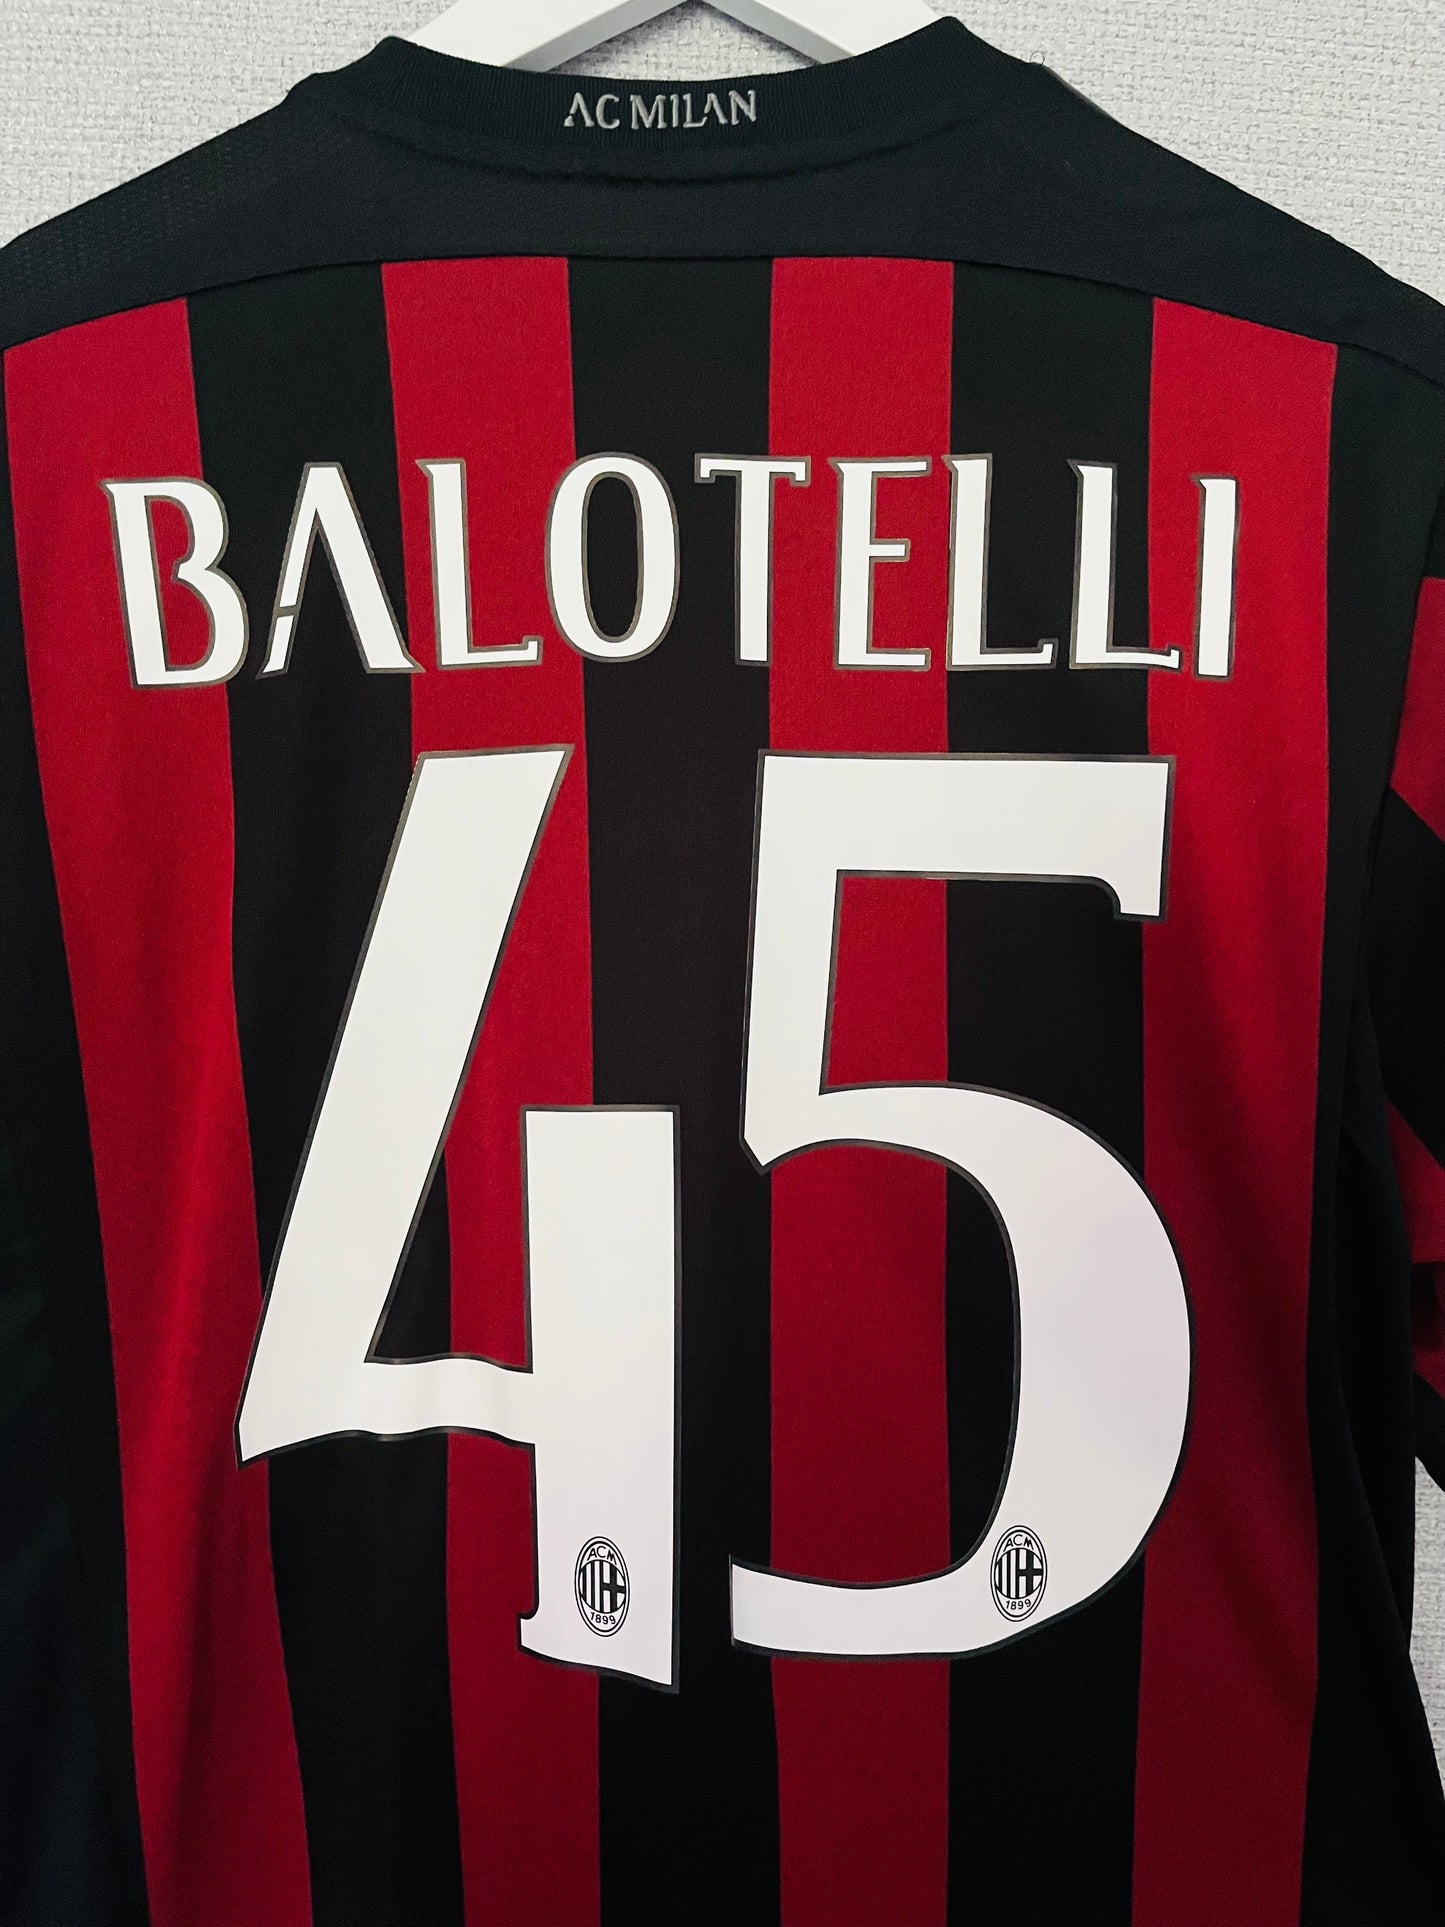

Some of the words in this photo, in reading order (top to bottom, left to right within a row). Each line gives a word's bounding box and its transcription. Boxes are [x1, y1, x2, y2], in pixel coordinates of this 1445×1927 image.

[564, 92, 620, 129] AC
[630, 90, 757, 129] MILAN
[101, 453, 1238, 688] BALOTELLI
[235, 744, 1194, 1692] 45
[1003, 1534, 1034, 1552] ACM
[587, 1546, 617, 1565] ACM
[1006, 1599, 1032, 1610] 1899
[590, 1612, 616, 1625] 1899
